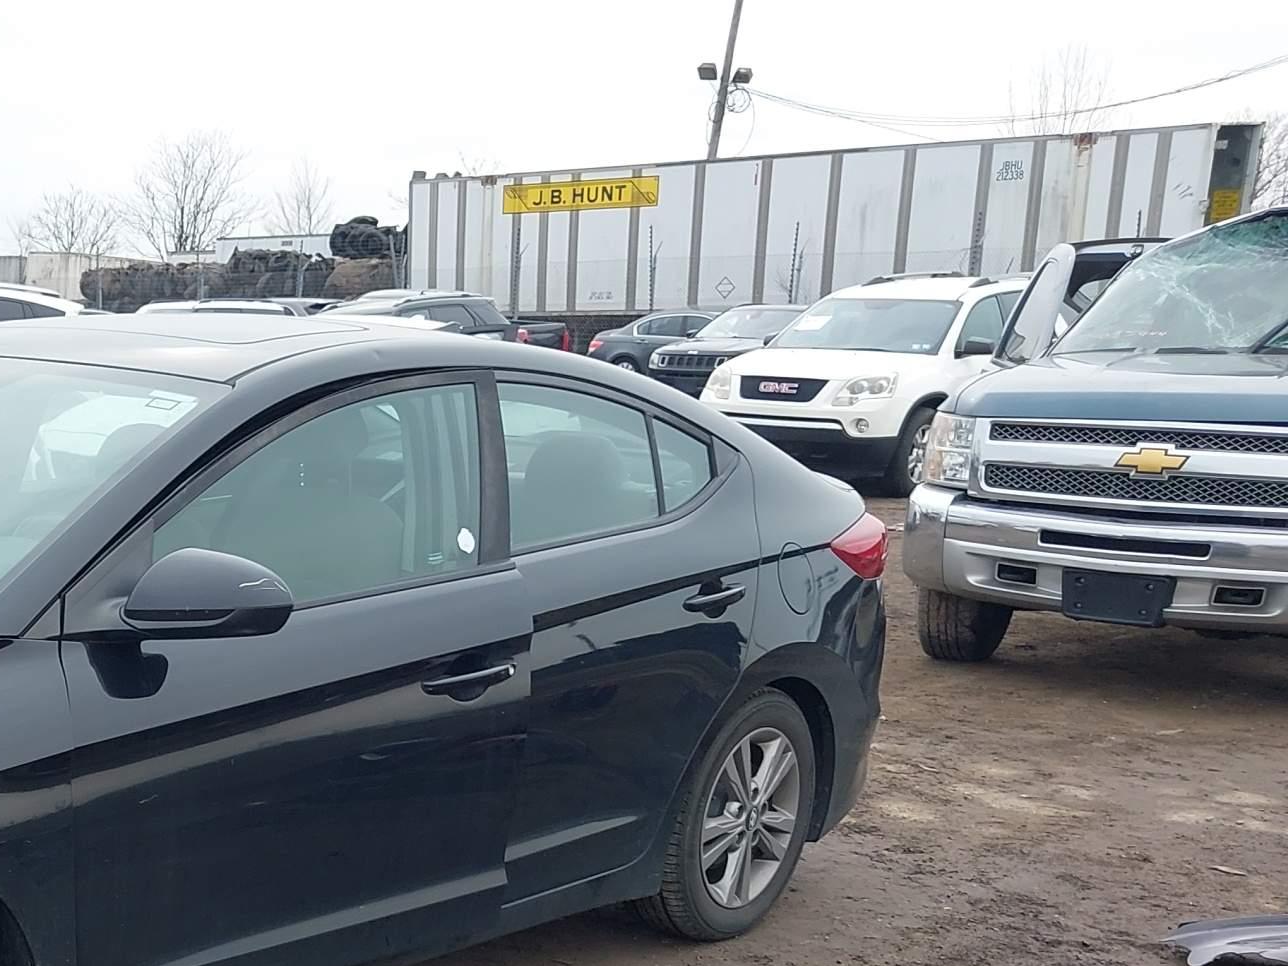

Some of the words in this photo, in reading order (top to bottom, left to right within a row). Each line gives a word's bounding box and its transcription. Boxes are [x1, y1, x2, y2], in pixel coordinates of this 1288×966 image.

[1000, 160, 1023, 171] JBHU
[572, 184, 627, 203] HUNT
[759, 381, 799, 394] GMC
